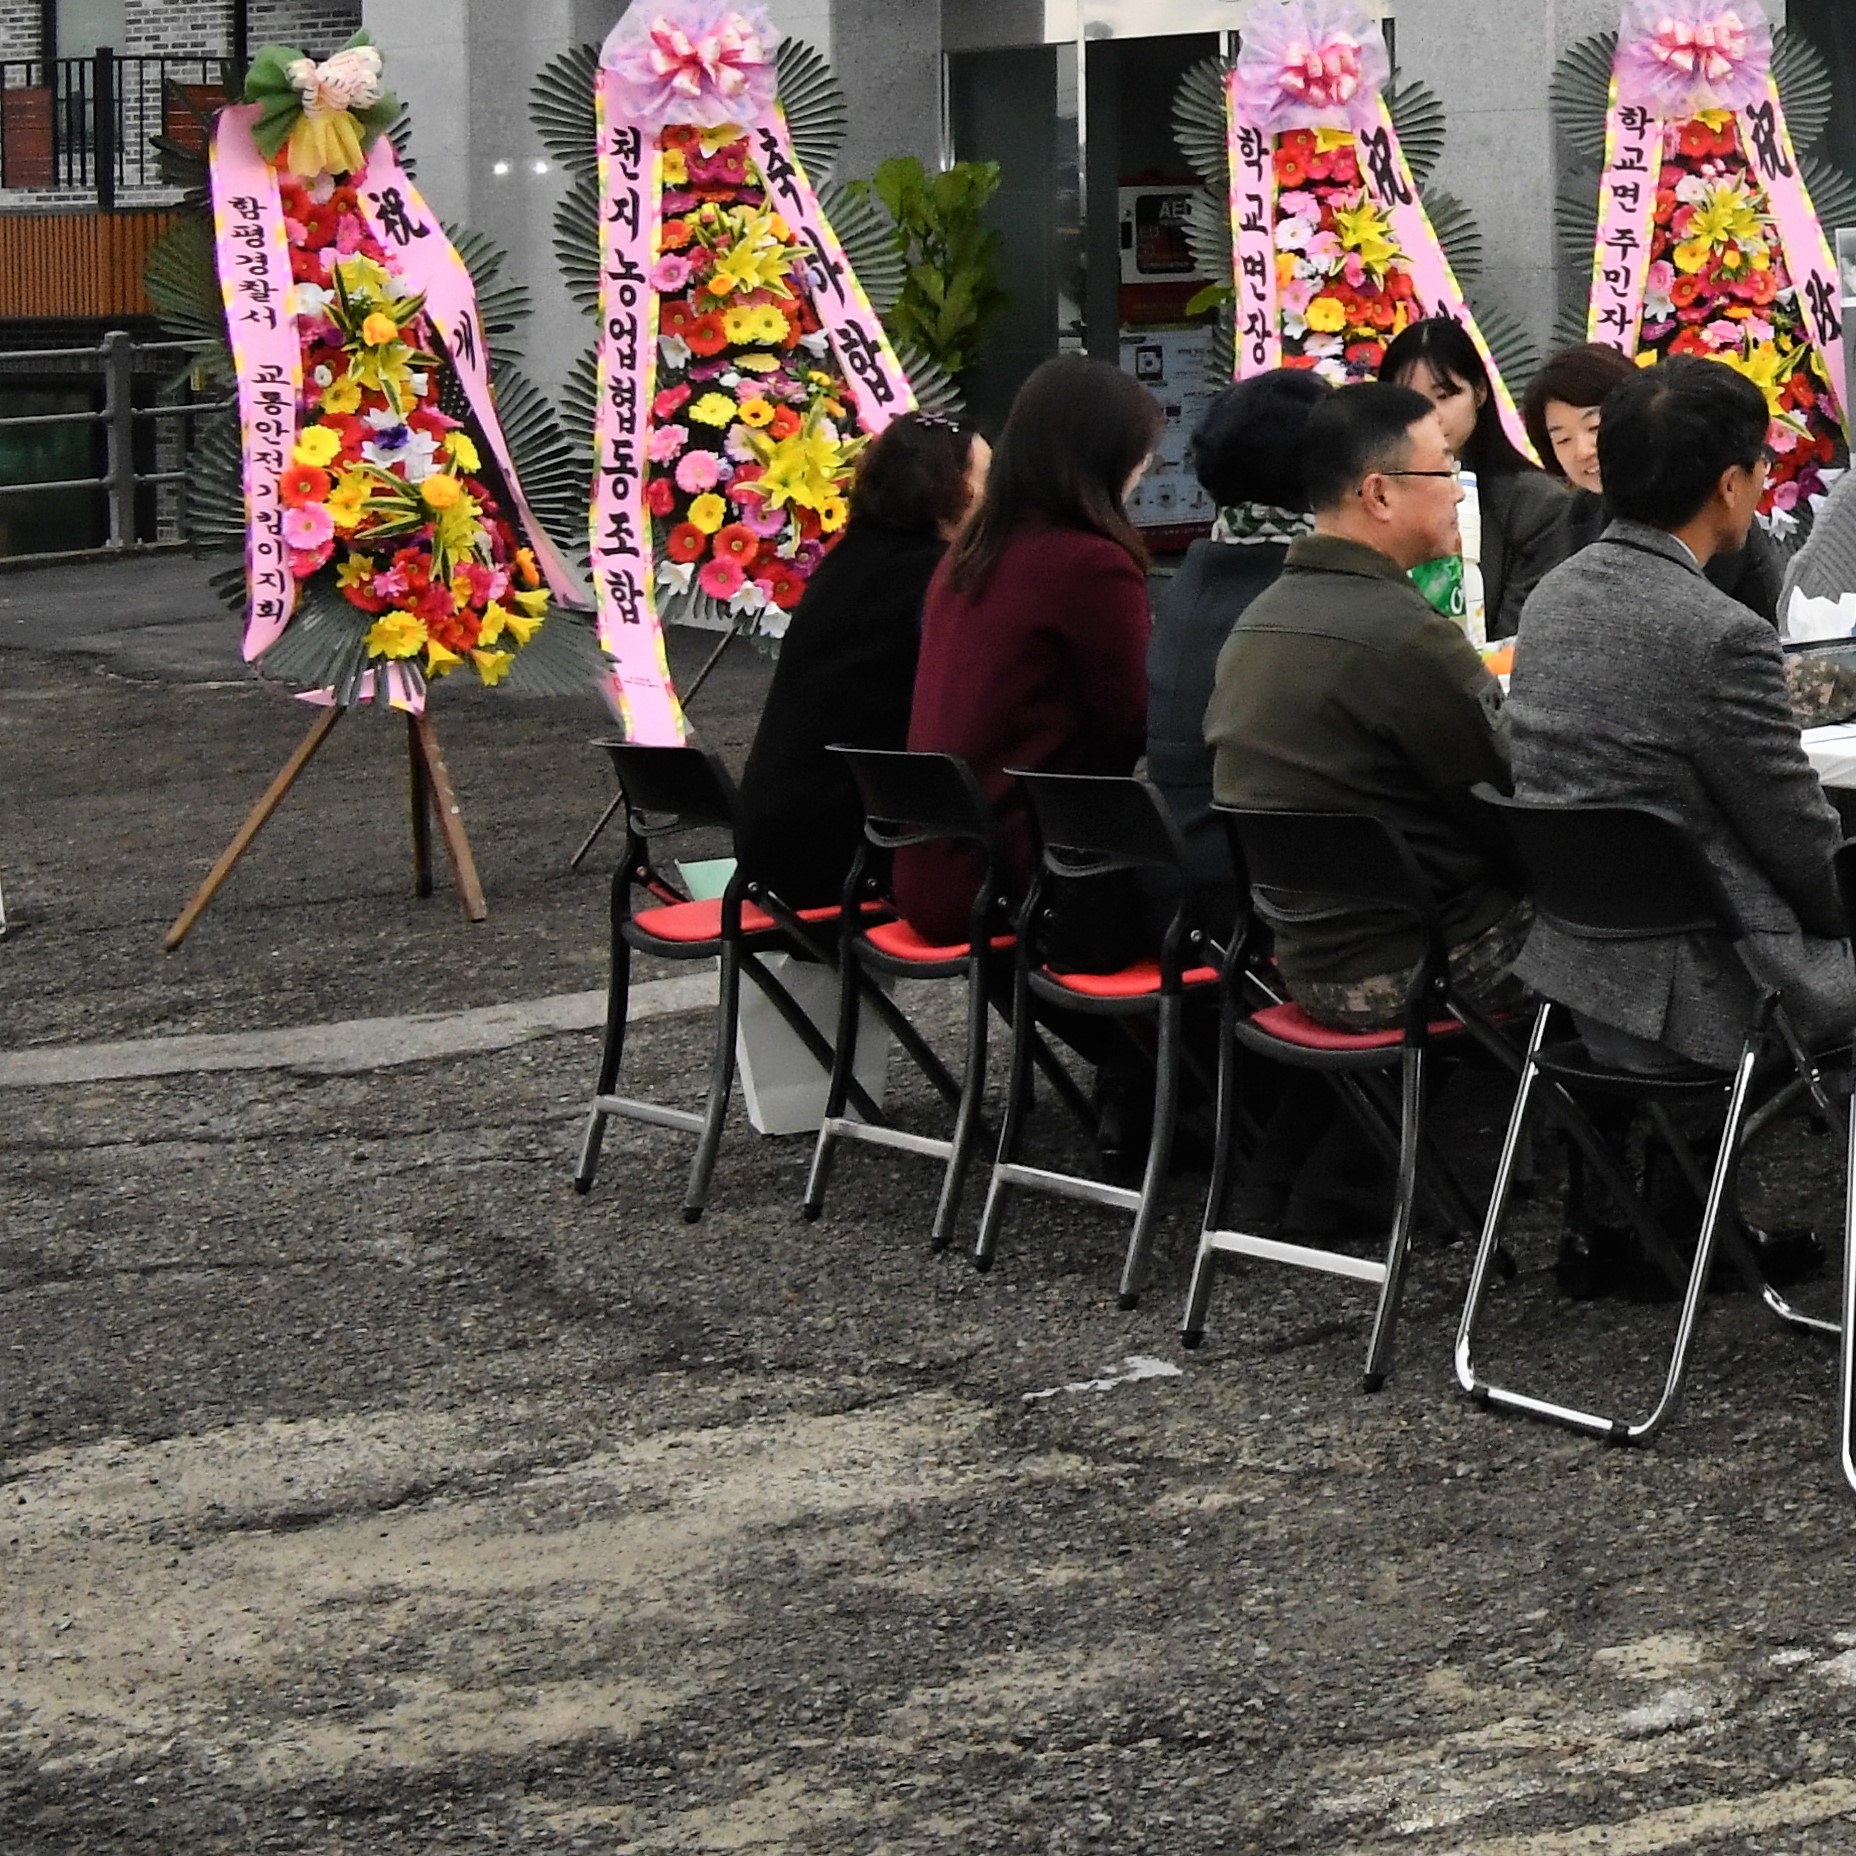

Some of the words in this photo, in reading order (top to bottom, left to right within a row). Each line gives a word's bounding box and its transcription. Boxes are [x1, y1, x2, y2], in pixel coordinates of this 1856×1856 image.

[227, 196, 279, 330] 함평경찰서
[369, 186, 431, 246] 祝
[756, 127, 900, 418] 축하합
[1236, 125, 1272, 365] 학교면장
[1597, 228, 1640, 354] 주민자
[602, 125, 646, 625] 천지농업협동조합
